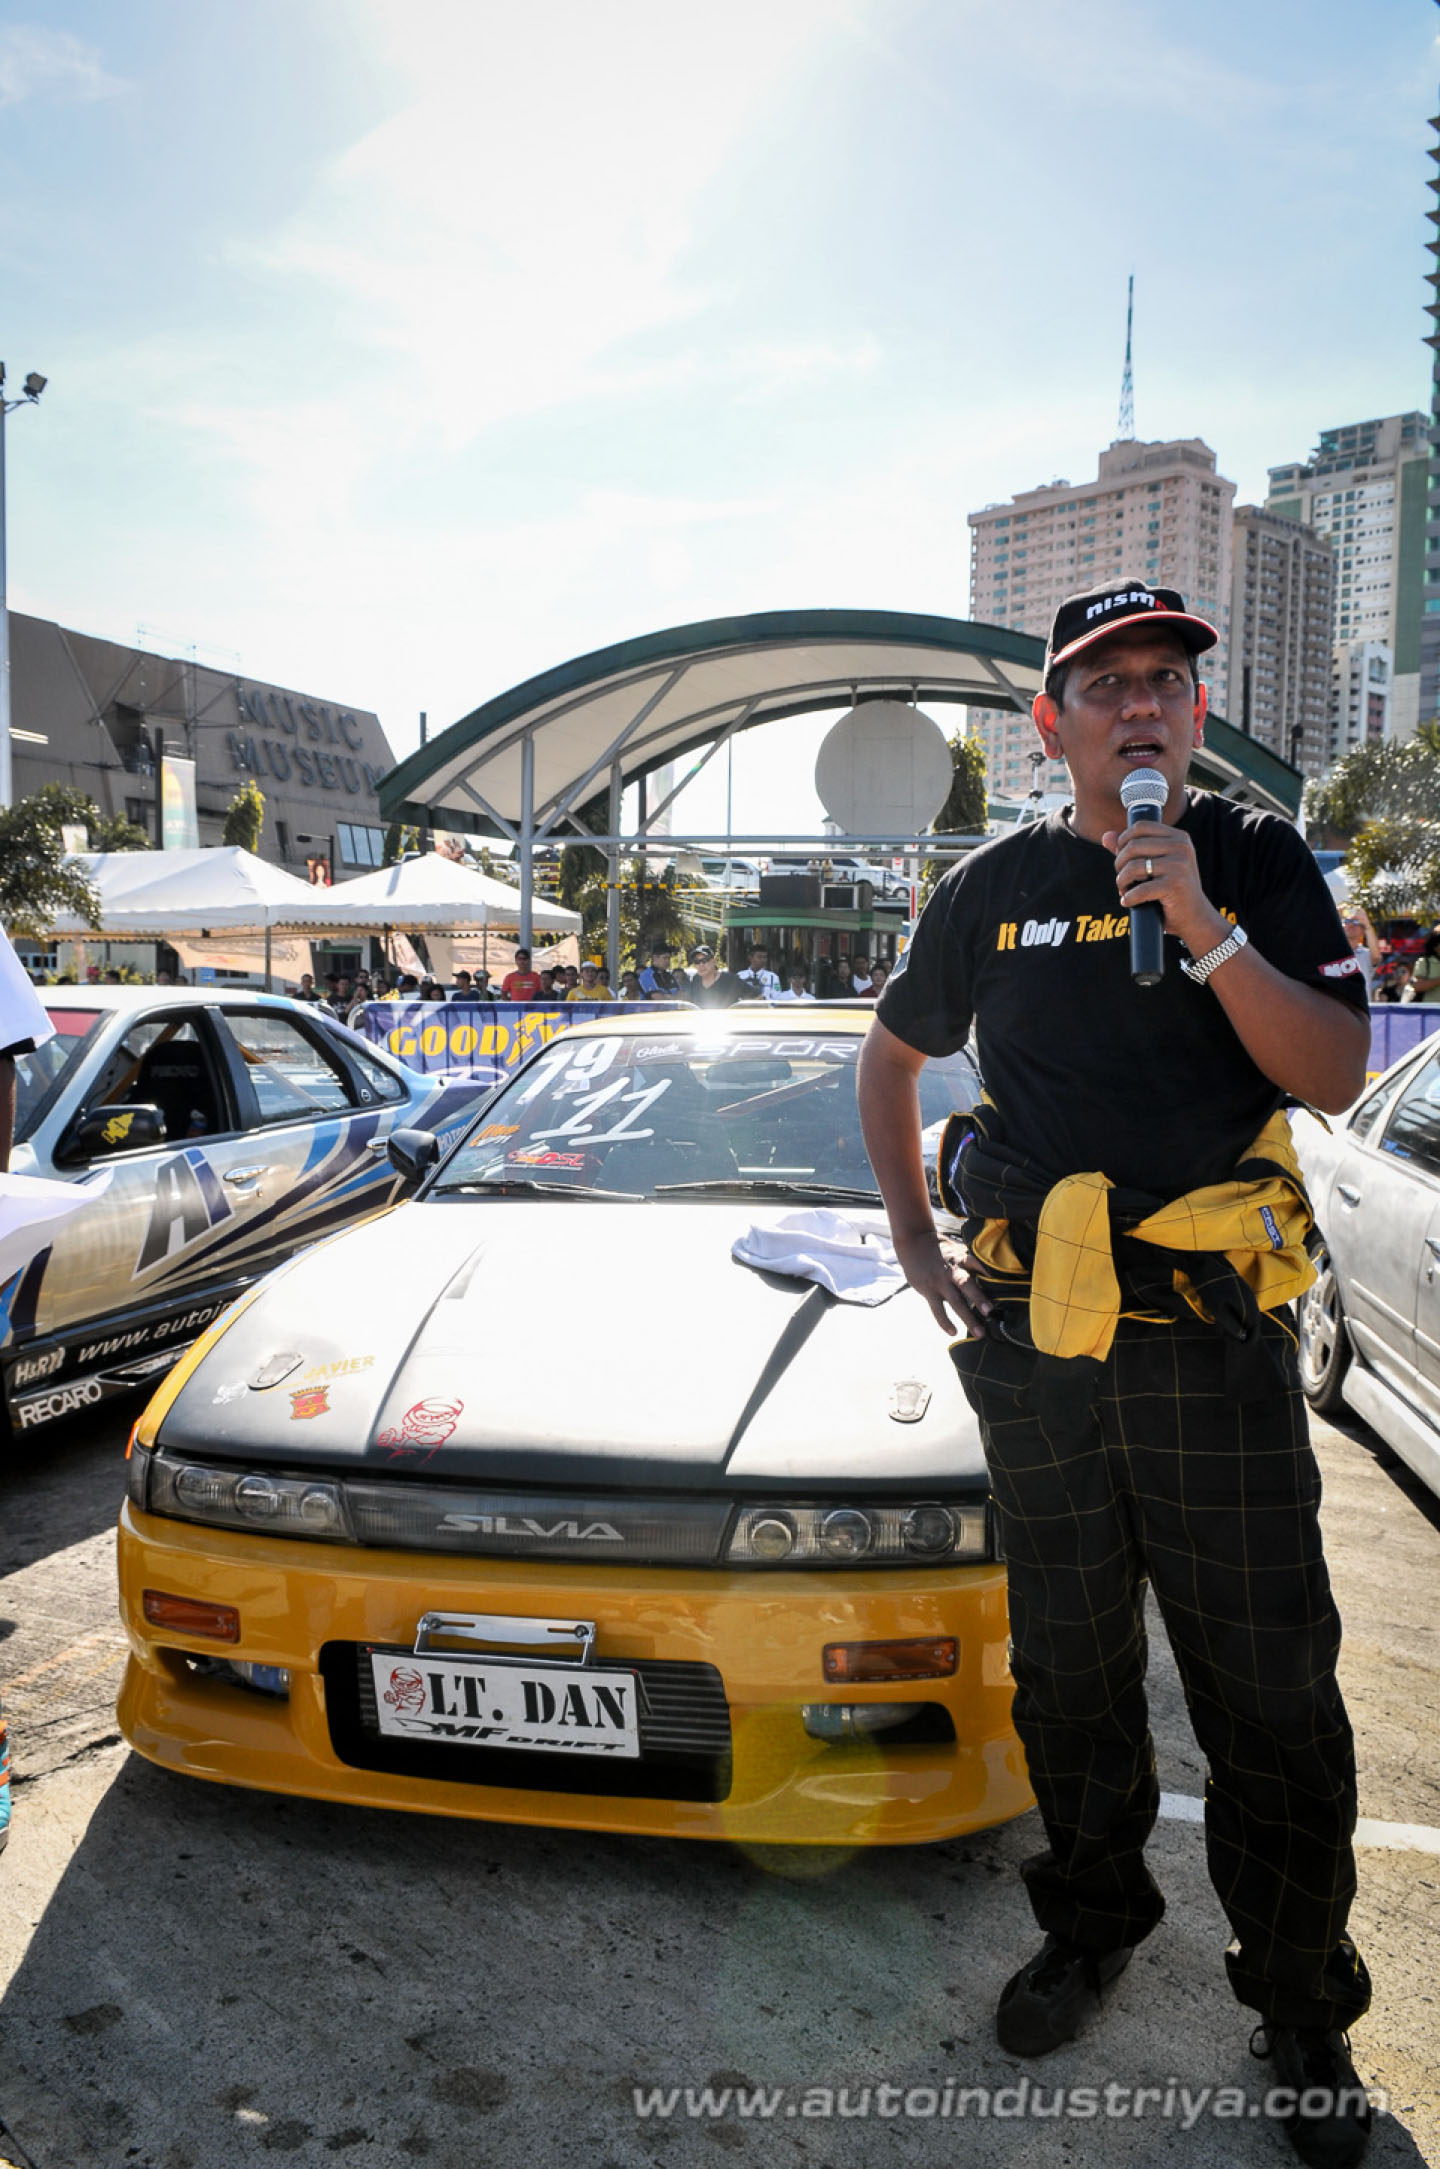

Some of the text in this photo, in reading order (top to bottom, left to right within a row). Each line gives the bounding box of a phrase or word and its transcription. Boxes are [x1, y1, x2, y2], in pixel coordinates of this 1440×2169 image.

[236, 689, 363, 750] MUSIC
[225, 732, 386, 797] MUSEUM
[997, 914, 1132, 951] It Only Take
[530, 1076, 672, 1146] 11
[304, 1355, 375, 1379] JAVIER
[18, 1382, 101, 1428] RECARO
[436, 1513, 625, 1540] SILVIA
[427, 1672, 627, 1730] LT. DAN
[506, 1736, 626, 1751] DRIFT
